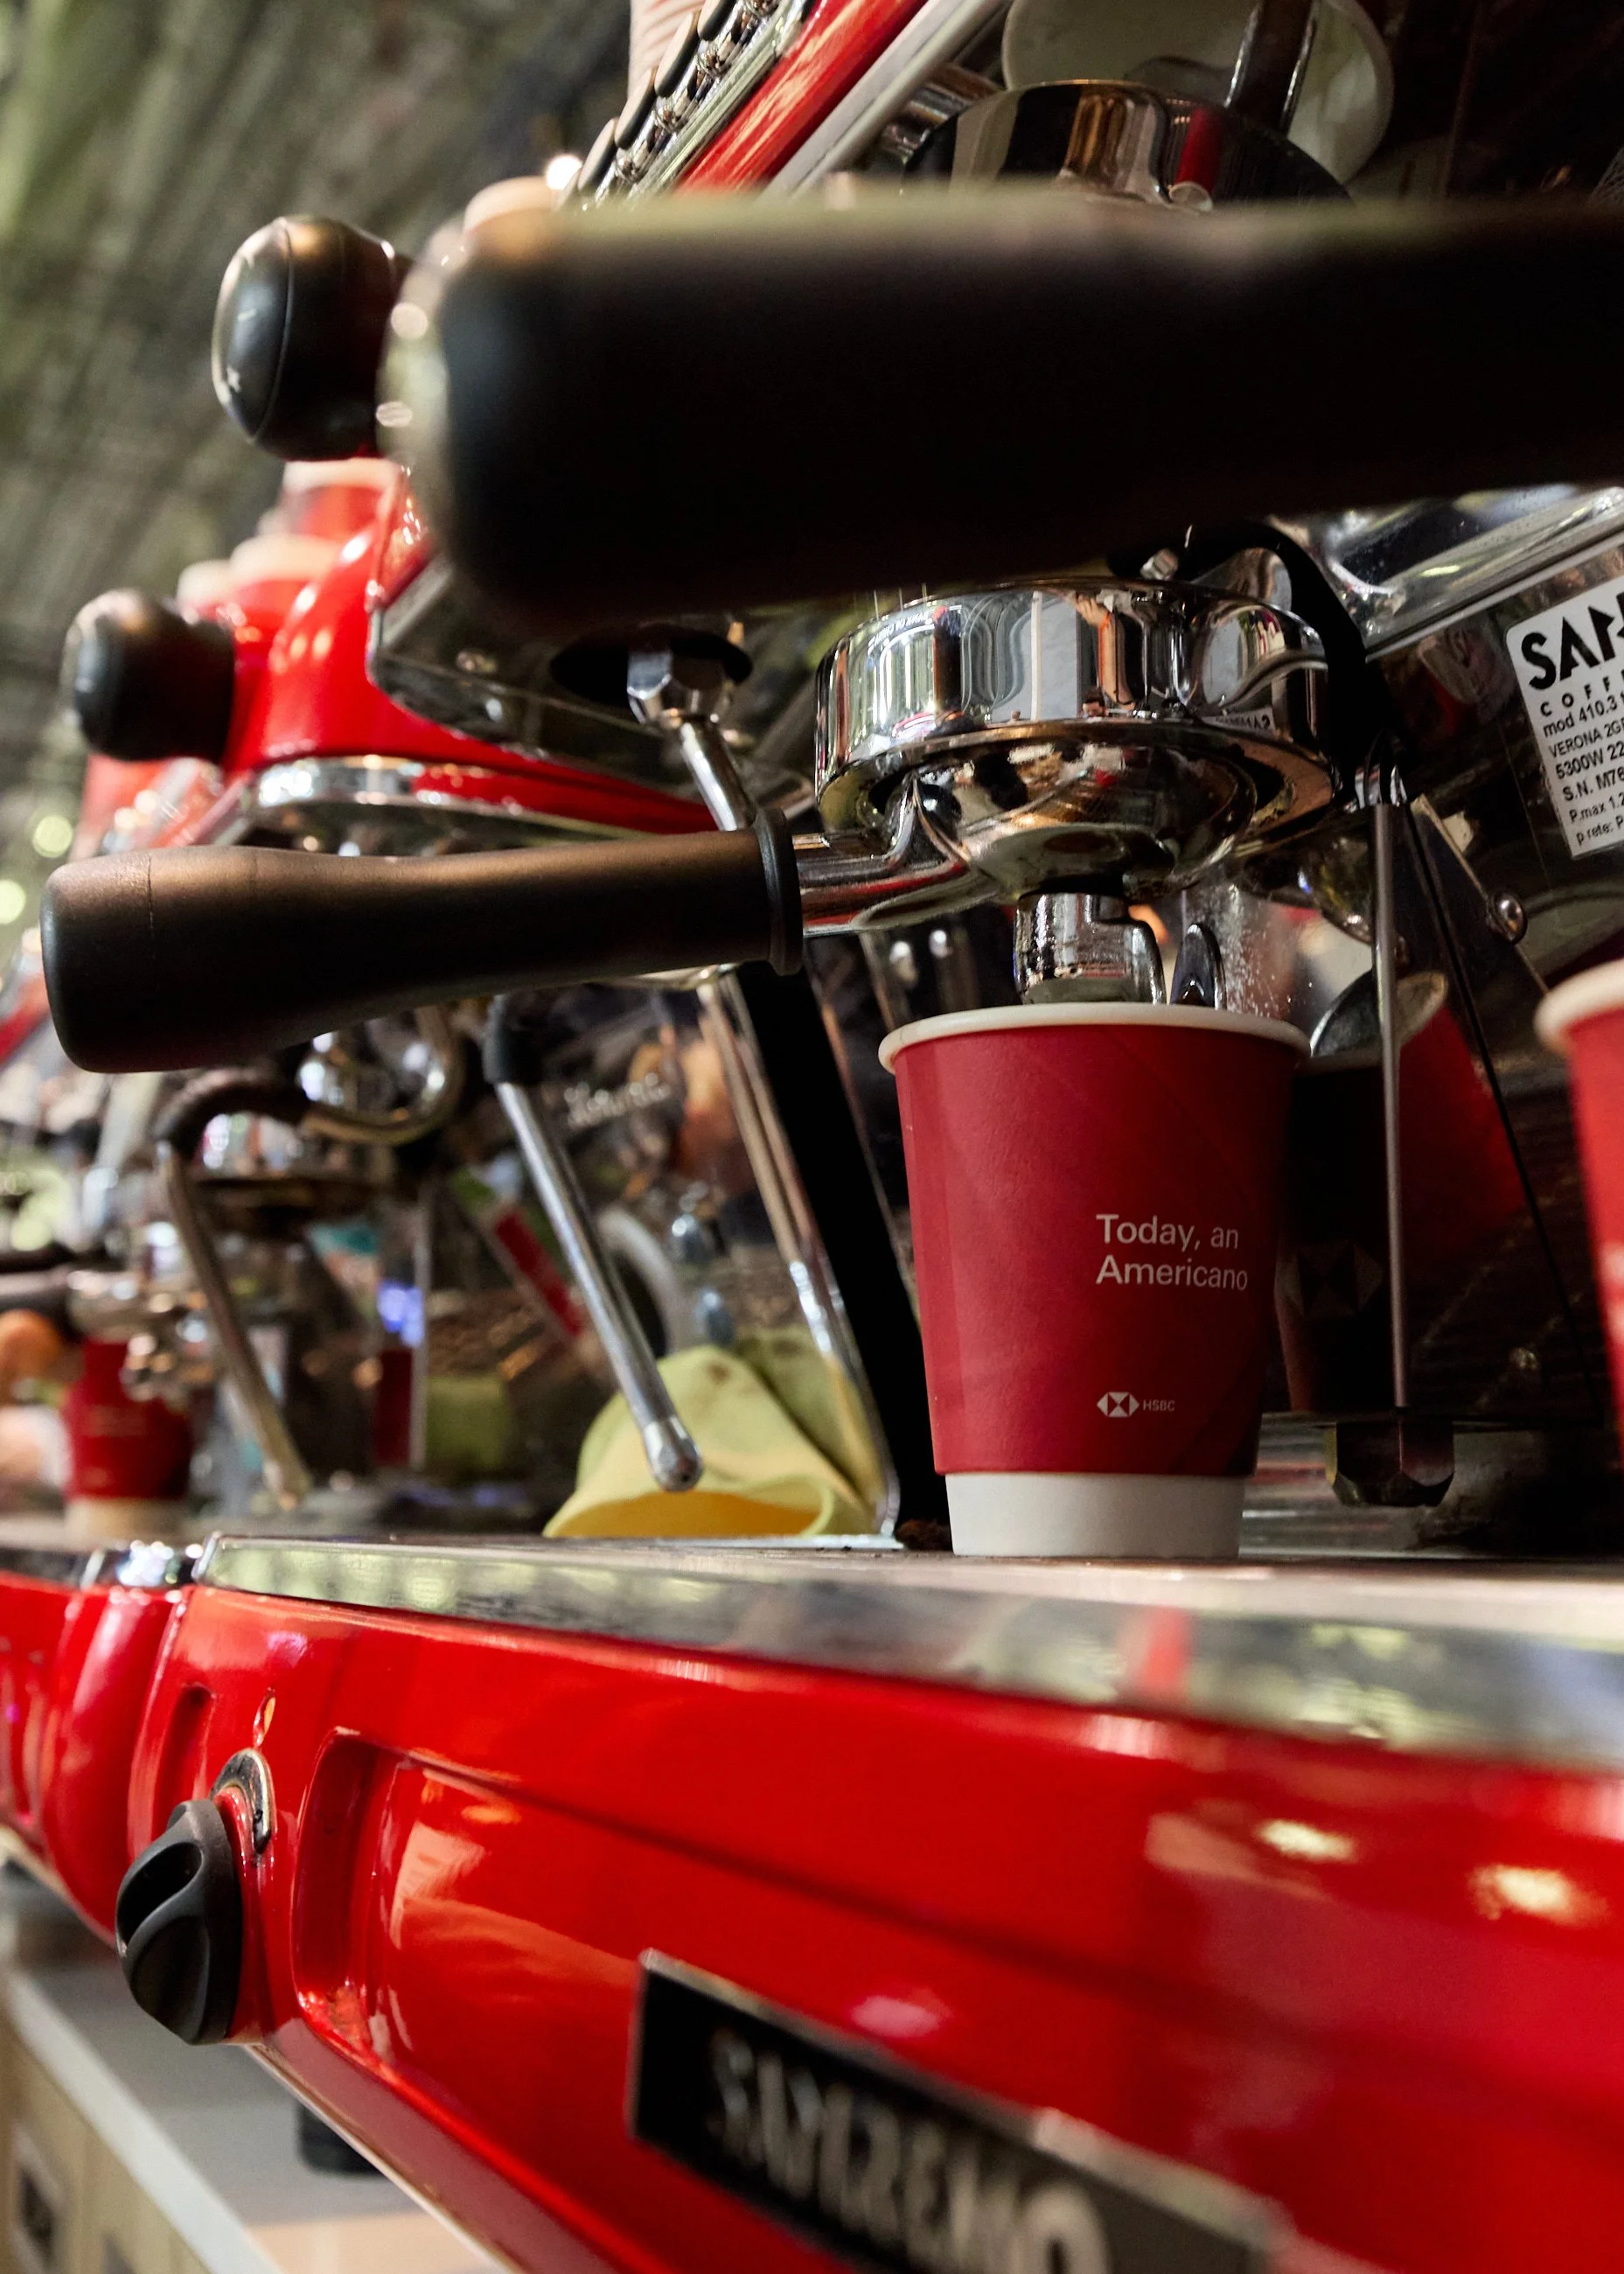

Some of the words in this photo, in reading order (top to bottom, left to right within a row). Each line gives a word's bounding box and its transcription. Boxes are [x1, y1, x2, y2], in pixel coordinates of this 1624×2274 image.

[1540, 670, 1624, 717] COFF
[1543, 712, 1575, 737] mod
[1579, 695, 1618, 722] 410.3
[1549, 728, 1603, 757] VERONA
[1556, 749, 1604, 779] 5300W
[1563, 780, 1593, 801] S.N.
[1096, 1213, 1201, 1252] Today,
[1210, 1226, 1239, 1250] an
[1096, 1254, 1249, 1292] Americano
[1142, 1399, 1176, 1412] HSBC
